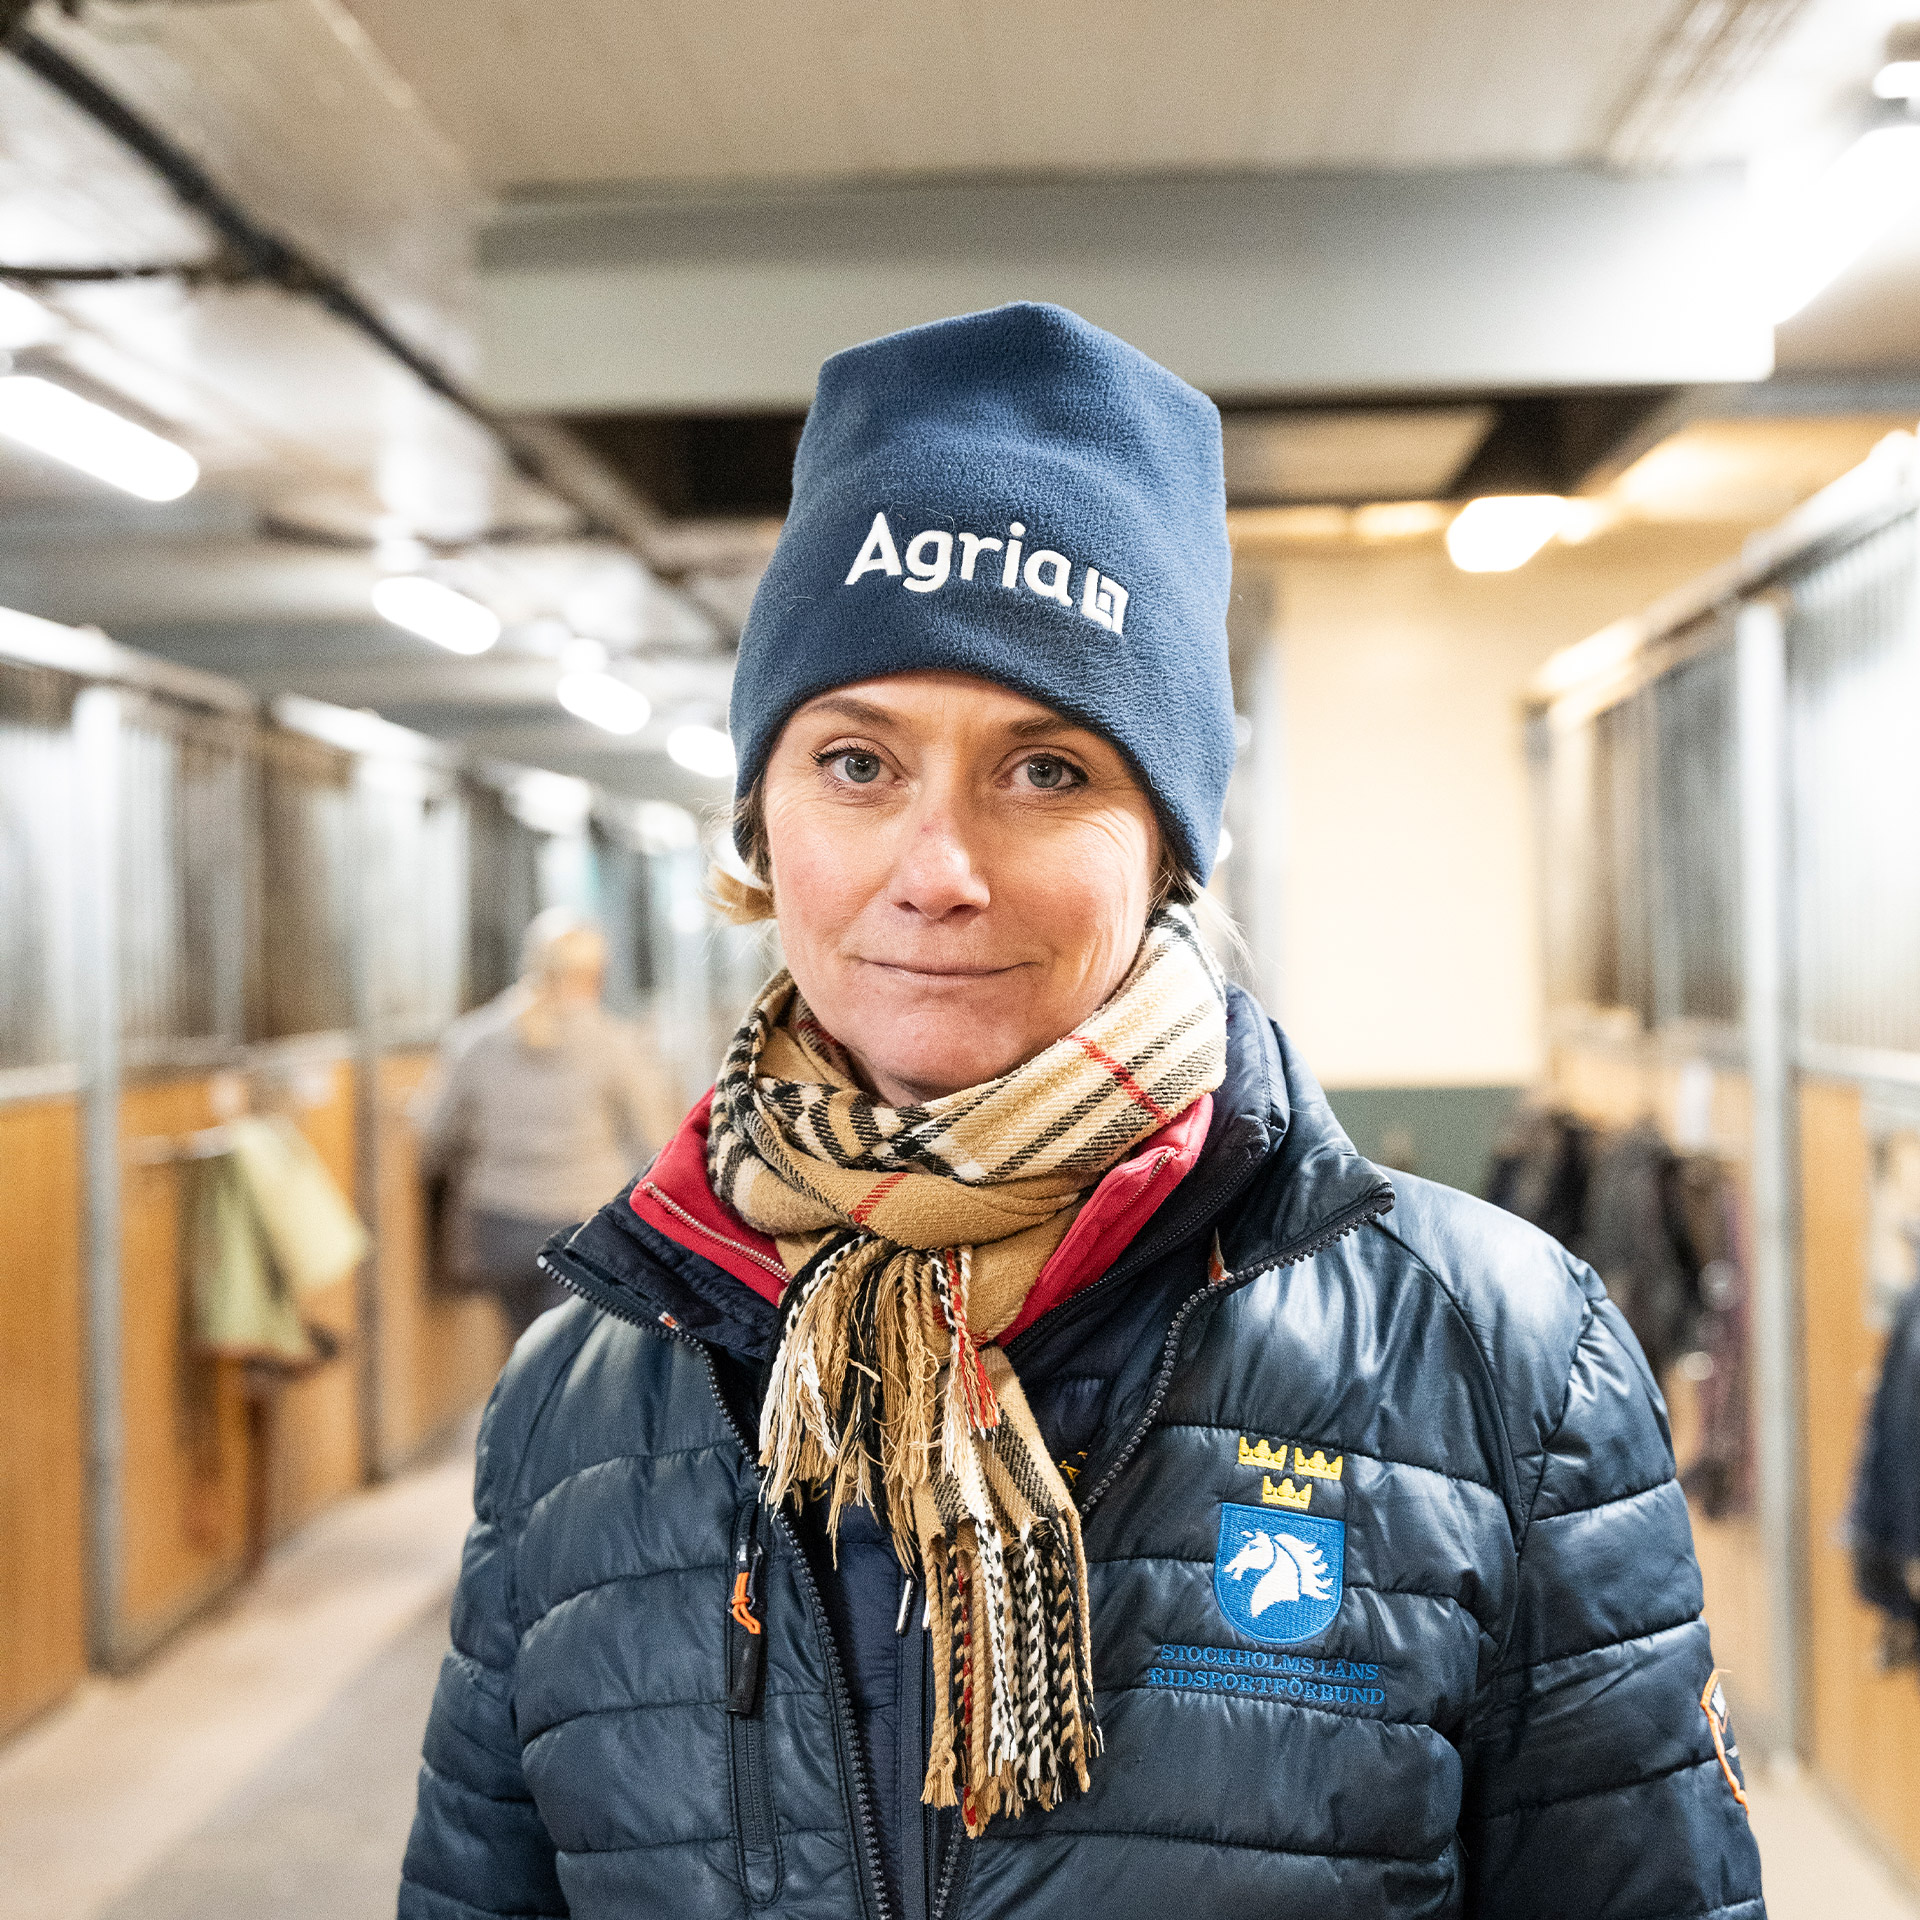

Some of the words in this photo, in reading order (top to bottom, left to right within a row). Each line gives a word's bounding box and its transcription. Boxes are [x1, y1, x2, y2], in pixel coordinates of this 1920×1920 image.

[844, 511, 1073, 607] Agria
[1160, 1643, 1315, 1674] STOCKHOLMS
[1147, 1667, 1385, 1705] RIDSPORTFÖRBUND
